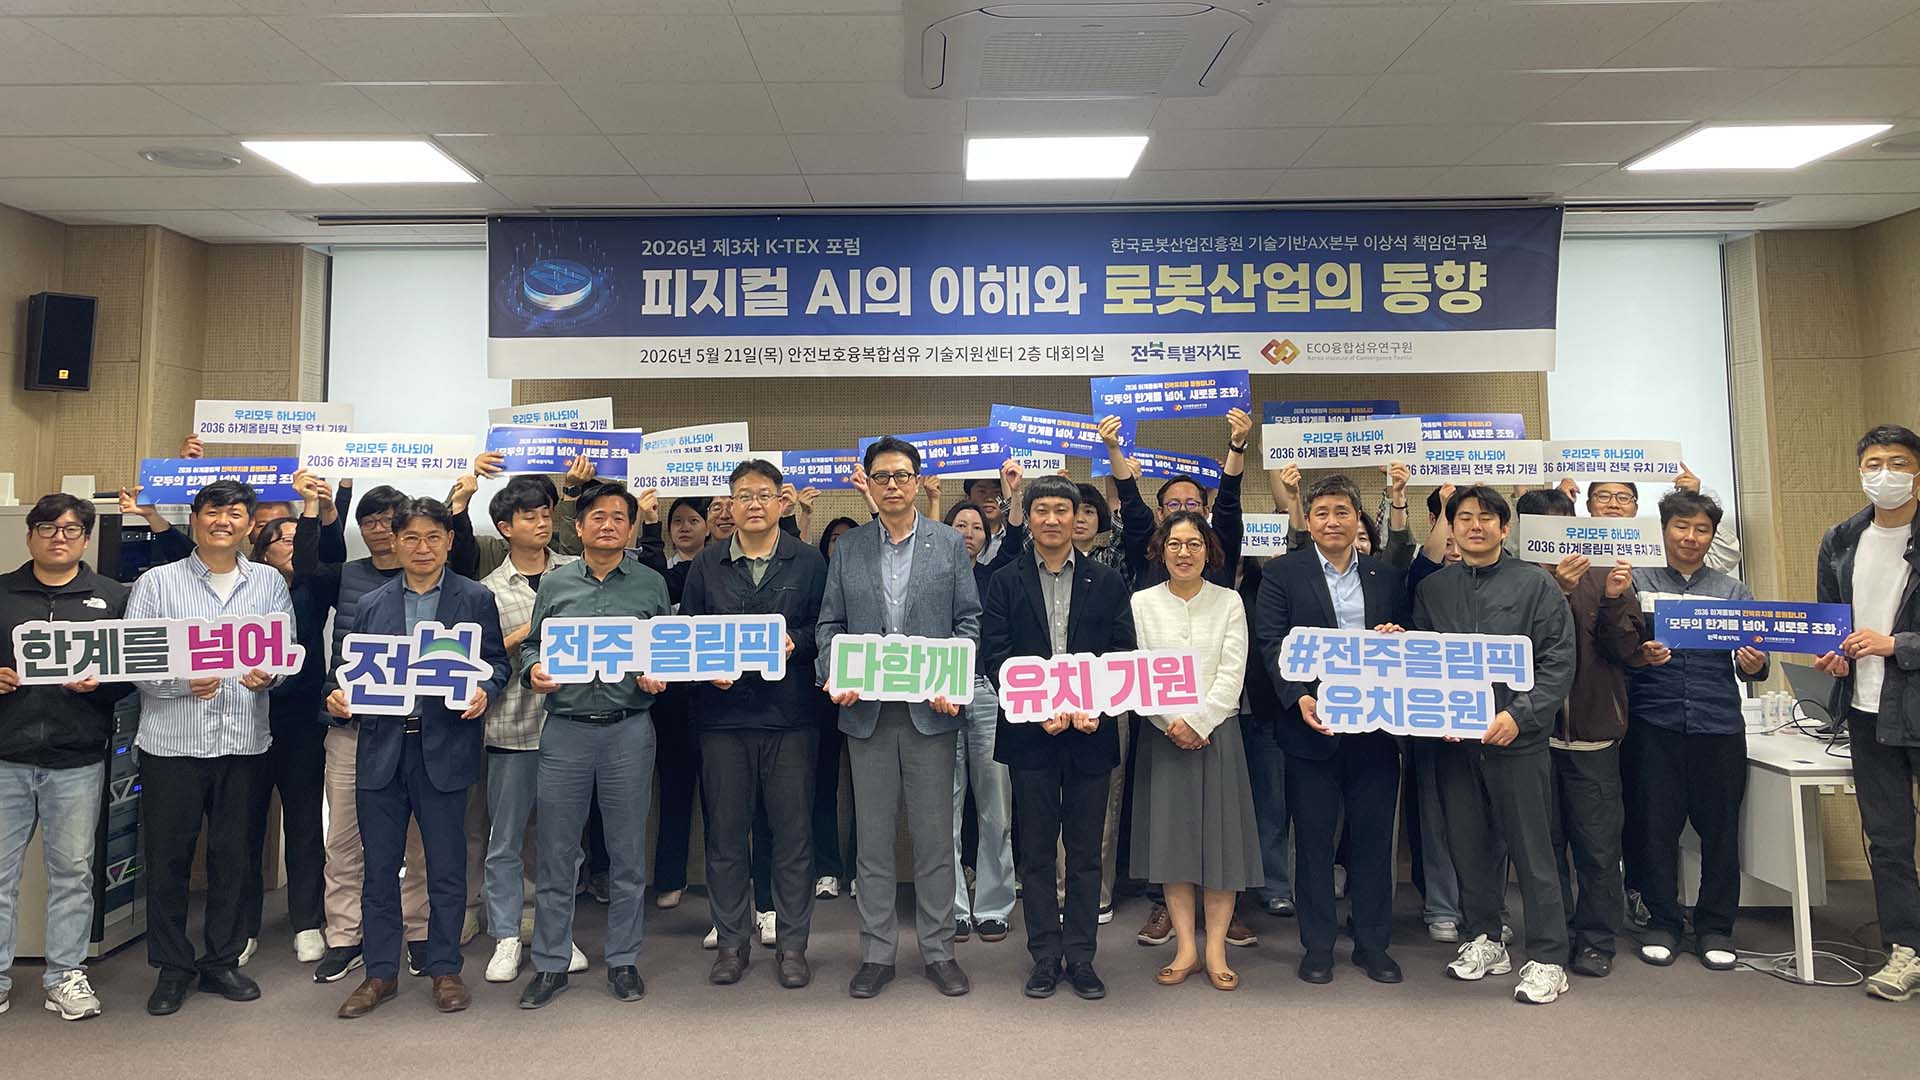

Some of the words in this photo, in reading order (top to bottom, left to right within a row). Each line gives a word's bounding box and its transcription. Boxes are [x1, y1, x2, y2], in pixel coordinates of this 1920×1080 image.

[641, 238, 706, 257] 2026년
[712, 237, 760, 257] 제3차
[765, 238, 820, 255] K-TEX
[825, 237, 861, 256] 포럼
[1111, 236, 1244, 254] 한국로봇산업진흥원
[1248, 234, 1359, 253] 기술기반AX본부
[1363, 234, 1407, 251] 이상석
[1412, 233, 1488, 251] 책임연구원
[641, 267, 789, 317] 피지컬
[805, 266, 912, 317] AI의
[930, 264, 1088, 316] 이해와
[1103, 262, 1363, 315] 로봇산업의
[1381, 260, 1488, 314] 동향
[1131, 341, 1241, 362] 전북특별자치도
[1306, 341, 1413, 354] ECO융합섬유연구원
[640, 347, 692, 364] 2026년
[696, 347, 719, 364] 5월
[723, 346, 783, 366] 21일(목)
[788, 345, 920, 363] 안전보호융복합섬유
[925, 345, 1013, 363] 기술지원센터
[1017, 346, 1041, 362] 2층
[1046, 345, 1105, 363] 대회의실
[234, 409, 273, 421] 우리모두
[277, 410, 316, 421] 하나되어
[512, 412, 541, 424] 우리모두
[543, 409, 579, 422] 하나되어
[200, 422, 225, 433] 2036
[228, 423, 279, 434] 하계올림픽
[282, 423, 301, 435] 전북
[679, 433, 714, 446] 하나되어
[1303, 432, 1343, 444] 우리모두
[1346, 430, 1384, 443] 하나되어
[345, 442, 388, 454] 우리모두
[391, 443, 434, 455] 하나되어
[726, 443, 743, 453] 기원
[1270, 447, 1294, 460] 2036
[1297, 445, 1348, 458] 하계올림픽
[1351, 444, 1371, 457] 전북
[1374, 443, 1394, 455] 유치
[1397, 442, 1416, 454] 기원
[1562, 448, 1600, 459] 우리모두
[1603, 449, 1644, 460] 하나되어
[307, 455, 334, 467] 2036
[337, 456, 392, 468] 하계올림픽
[396, 457, 418, 469] 전북
[421, 457, 442, 469] 유치
[446, 458, 468, 469] 기원
[1425, 450, 1465, 461] 우리모두
[1467, 450, 1506, 462] 하나되어
[666, 462, 704, 473] 우리모두
[1023, 459, 1041, 470] 유치
[1043, 459, 1060, 470] 기원
[1420, 464, 1471, 476] 하계올림픽
[1474, 464, 1493, 476] 전북
[1496, 464, 1515, 475] 유치
[1518, 463, 1537, 475] 기원
[1543, 462, 1553, 473] 36
[1556, 461, 1606, 473] 하계올림픽
[1610, 462, 1630, 473] 전북
[1633, 462, 1654, 473] 유치
[1657, 462, 1678, 474] 기원
[634, 476, 657, 488] 2036
[660, 475, 709, 487] 하계올림픽
[1246, 522, 1281, 533] 하나되어
[1566, 527, 1608, 540] 우리모두
[1611, 528, 1640, 540] 하나되어
[1251, 536, 1269, 547] 전북
[1528, 540, 1555, 553] 2036
[1559, 542, 1613, 555] 하계올림픽
[1616, 543, 1633, 556] 전북
[1634, 544, 1647, 556] 유치
[1649, 544, 1662, 556] 기원
[1706, 619, 1739, 631] 한계를
[1773, 621, 1809, 634] 새로운
[20, 626, 169, 678] 한계를
[188, 620, 297, 671] 넘어,
[546, 624, 633, 675] 전주
[649, 622, 779, 673] 올림픽
[1287, 634, 1526, 684] #전주올림픽
[344, 629, 484, 707] 전북
[836, 641, 969, 697] 다함께
[1005, 660, 1095, 715] 유치
[1106, 655, 1199, 708] 기원
[1324, 685, 1489, 731] 유치응원
